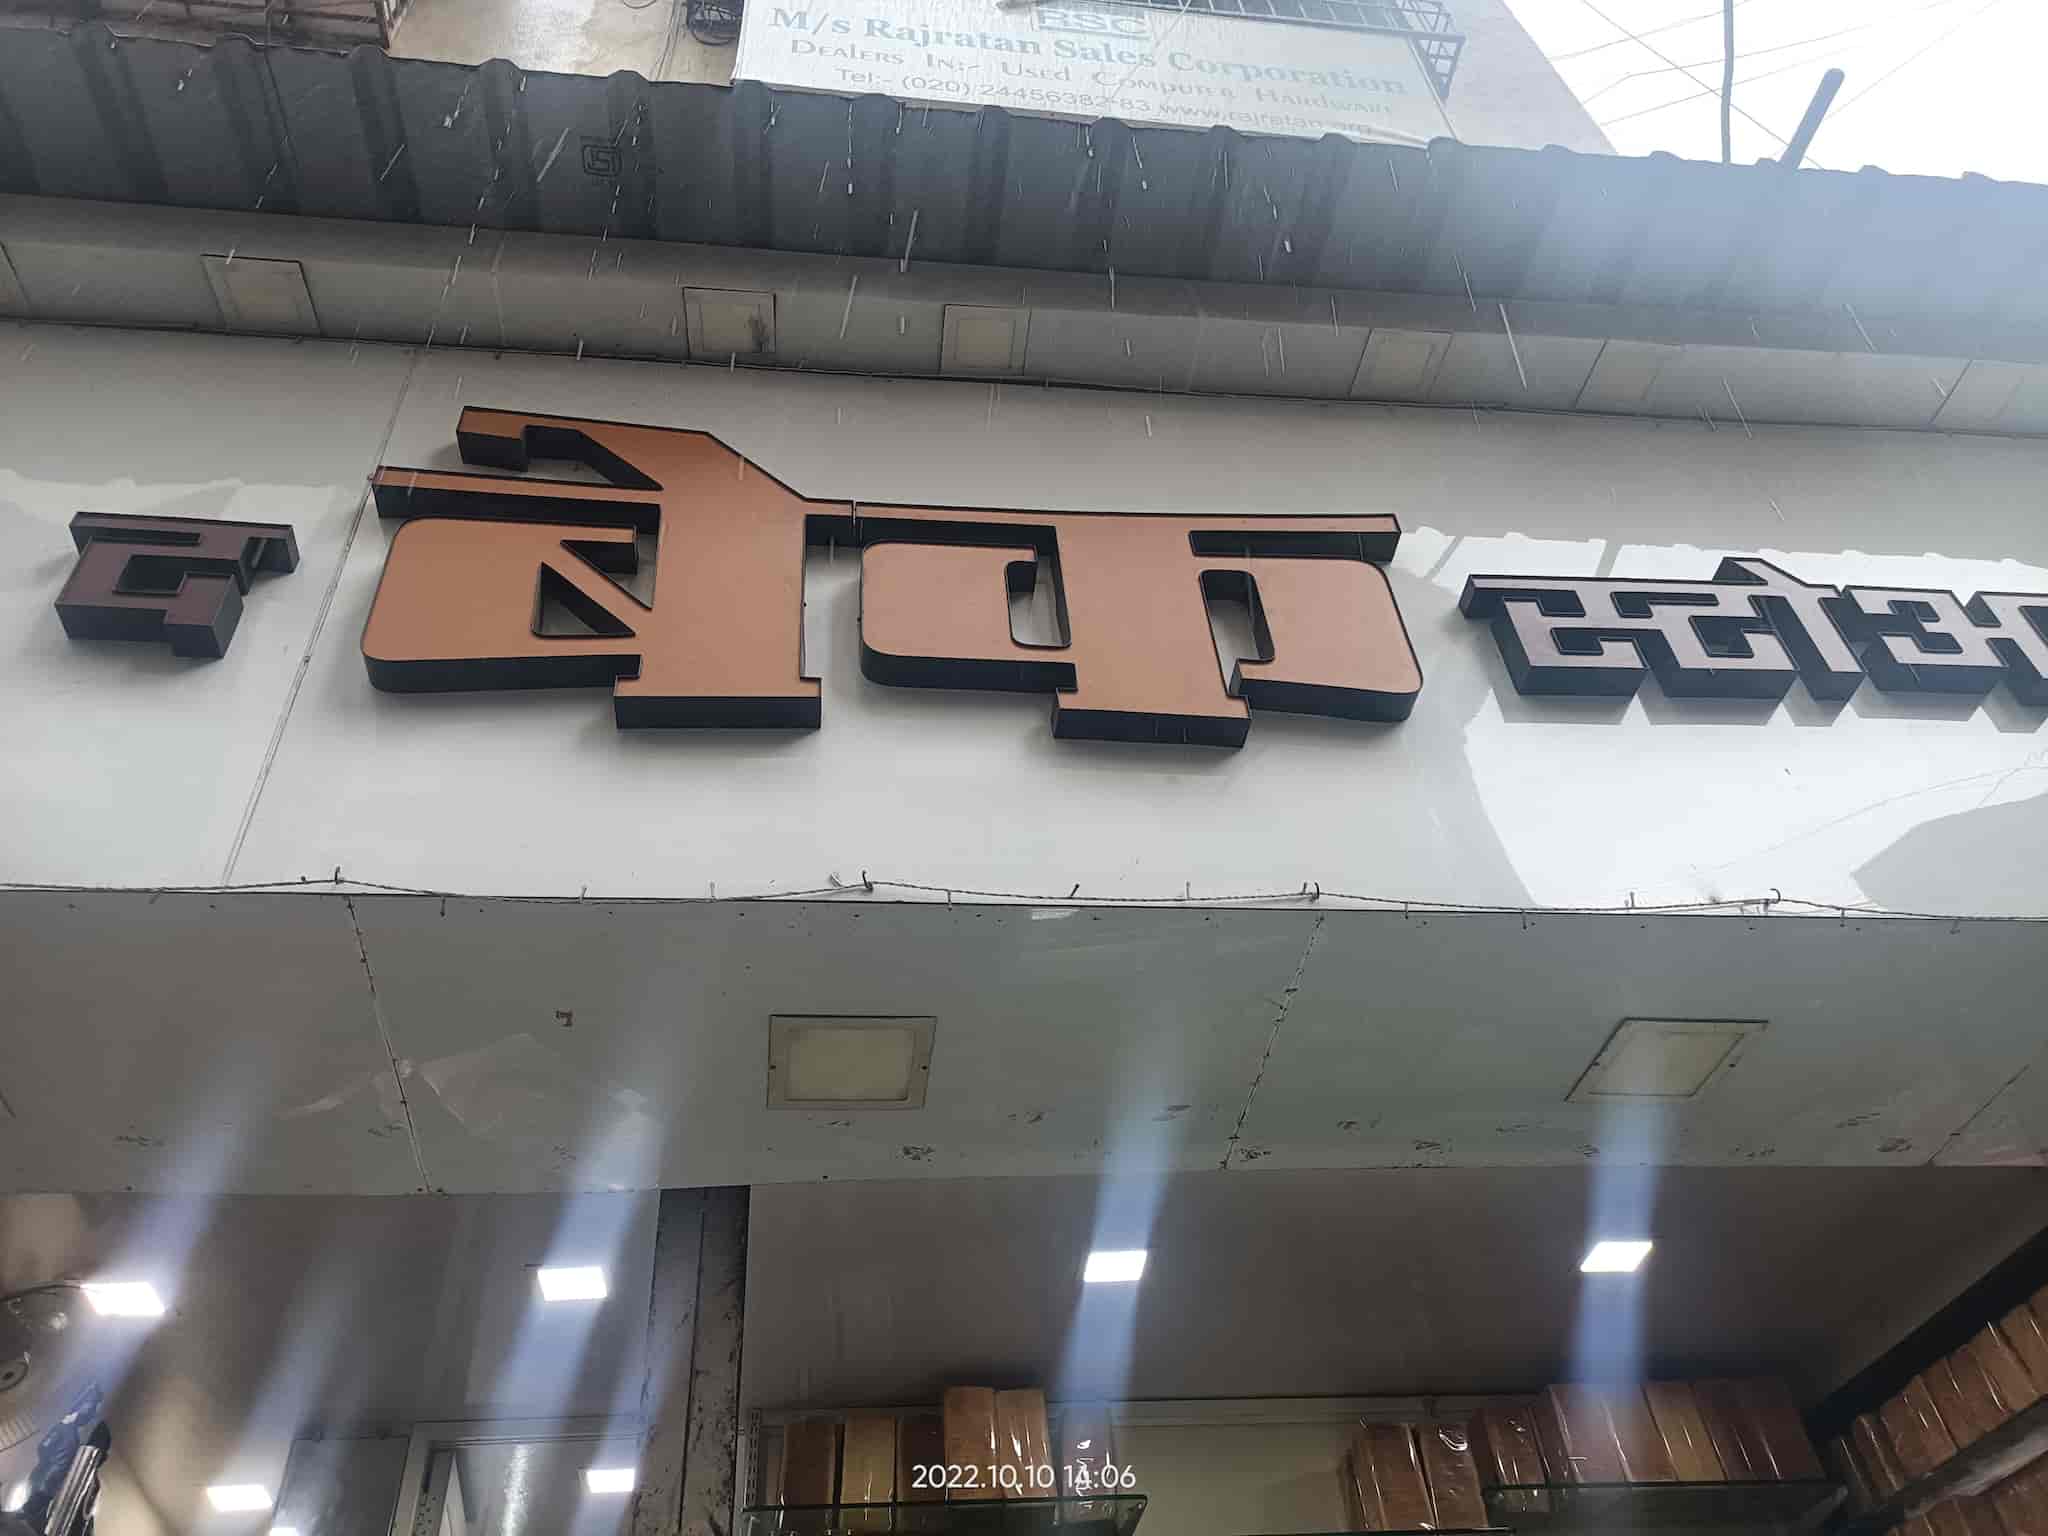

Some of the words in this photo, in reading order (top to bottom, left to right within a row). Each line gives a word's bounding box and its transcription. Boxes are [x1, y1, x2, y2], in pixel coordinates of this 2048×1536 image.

[769, 8, 850, 34] M/s
[864, 18, 1041, 56] Rajratan
[1053, 39, 1156, 68] Sales
[1168, 51, 1408, 94] Corporation
